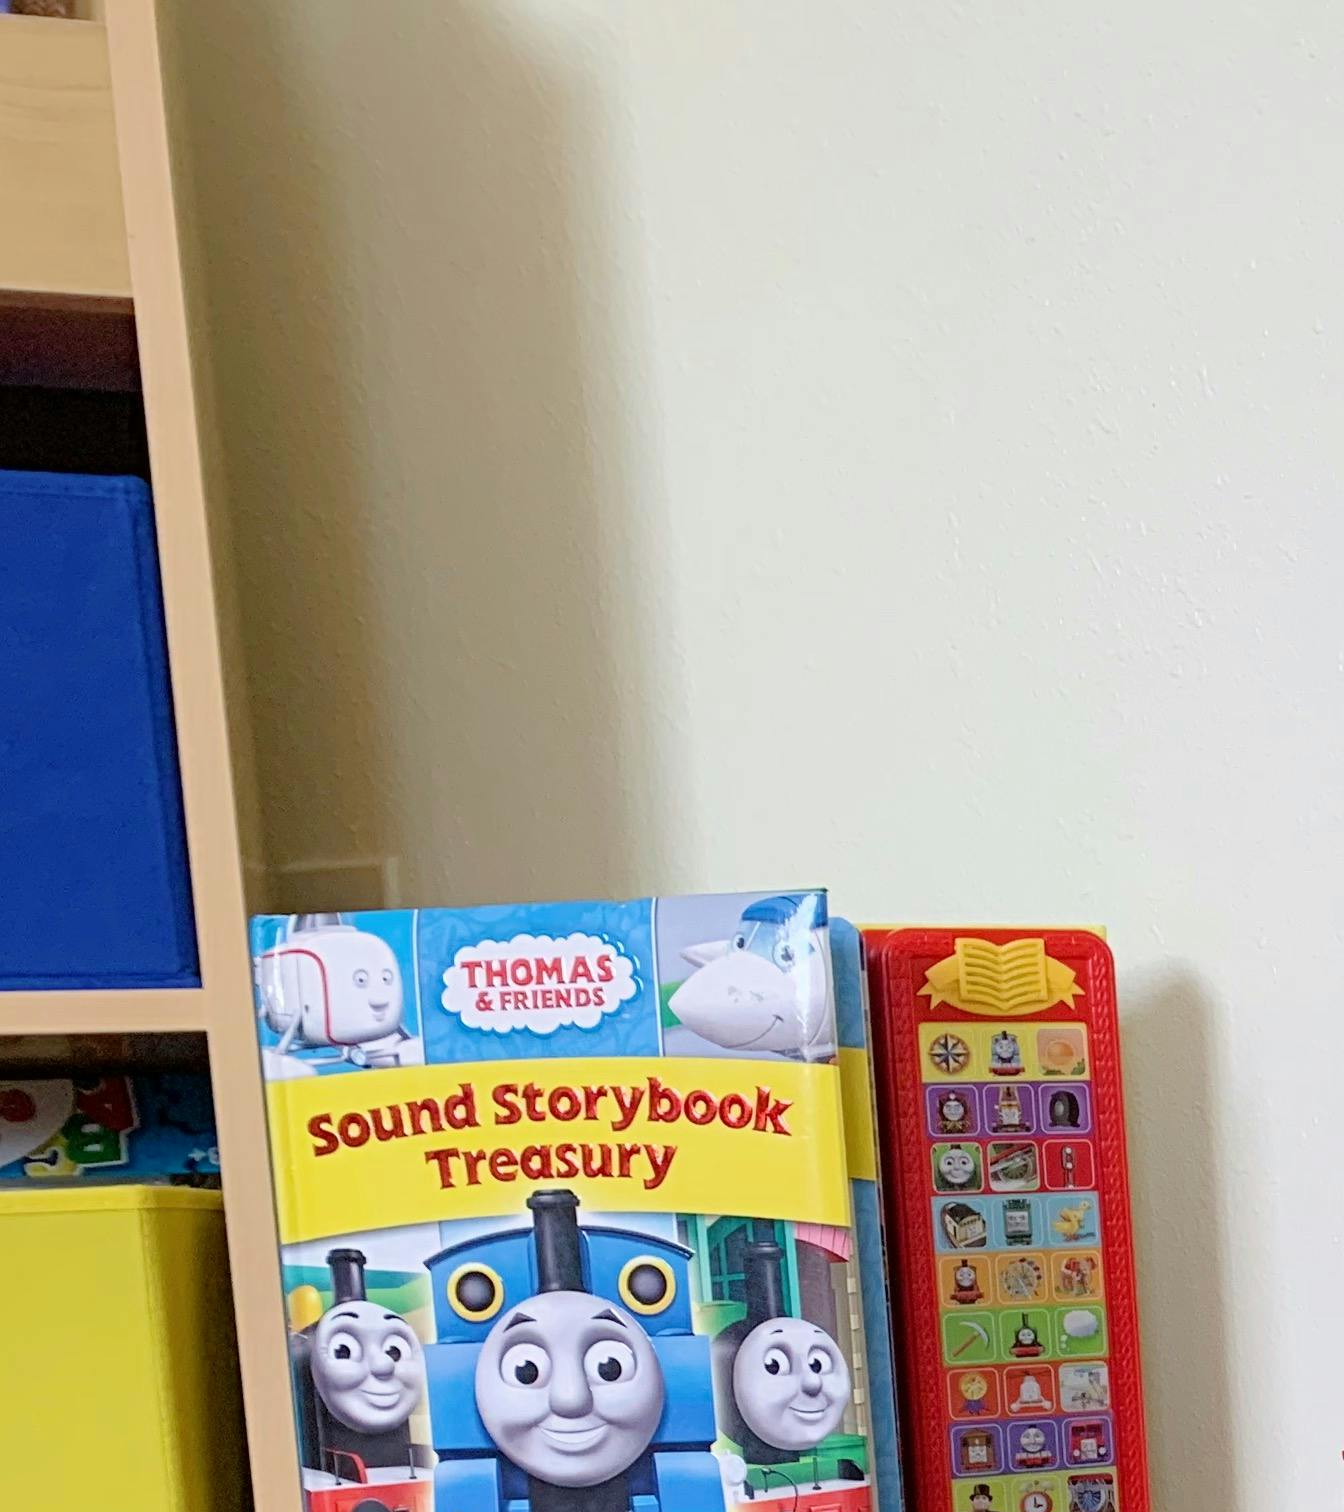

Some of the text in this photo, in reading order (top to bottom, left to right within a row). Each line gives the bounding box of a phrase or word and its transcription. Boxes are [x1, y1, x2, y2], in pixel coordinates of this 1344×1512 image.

[460, 954, 614, 988] THOMAS
[475, 987, 606, 1012] & FRIENDS
[306, 1076, 795, 1157] Sound Storybook
[424, 1142, 679, 1190] Treasury
